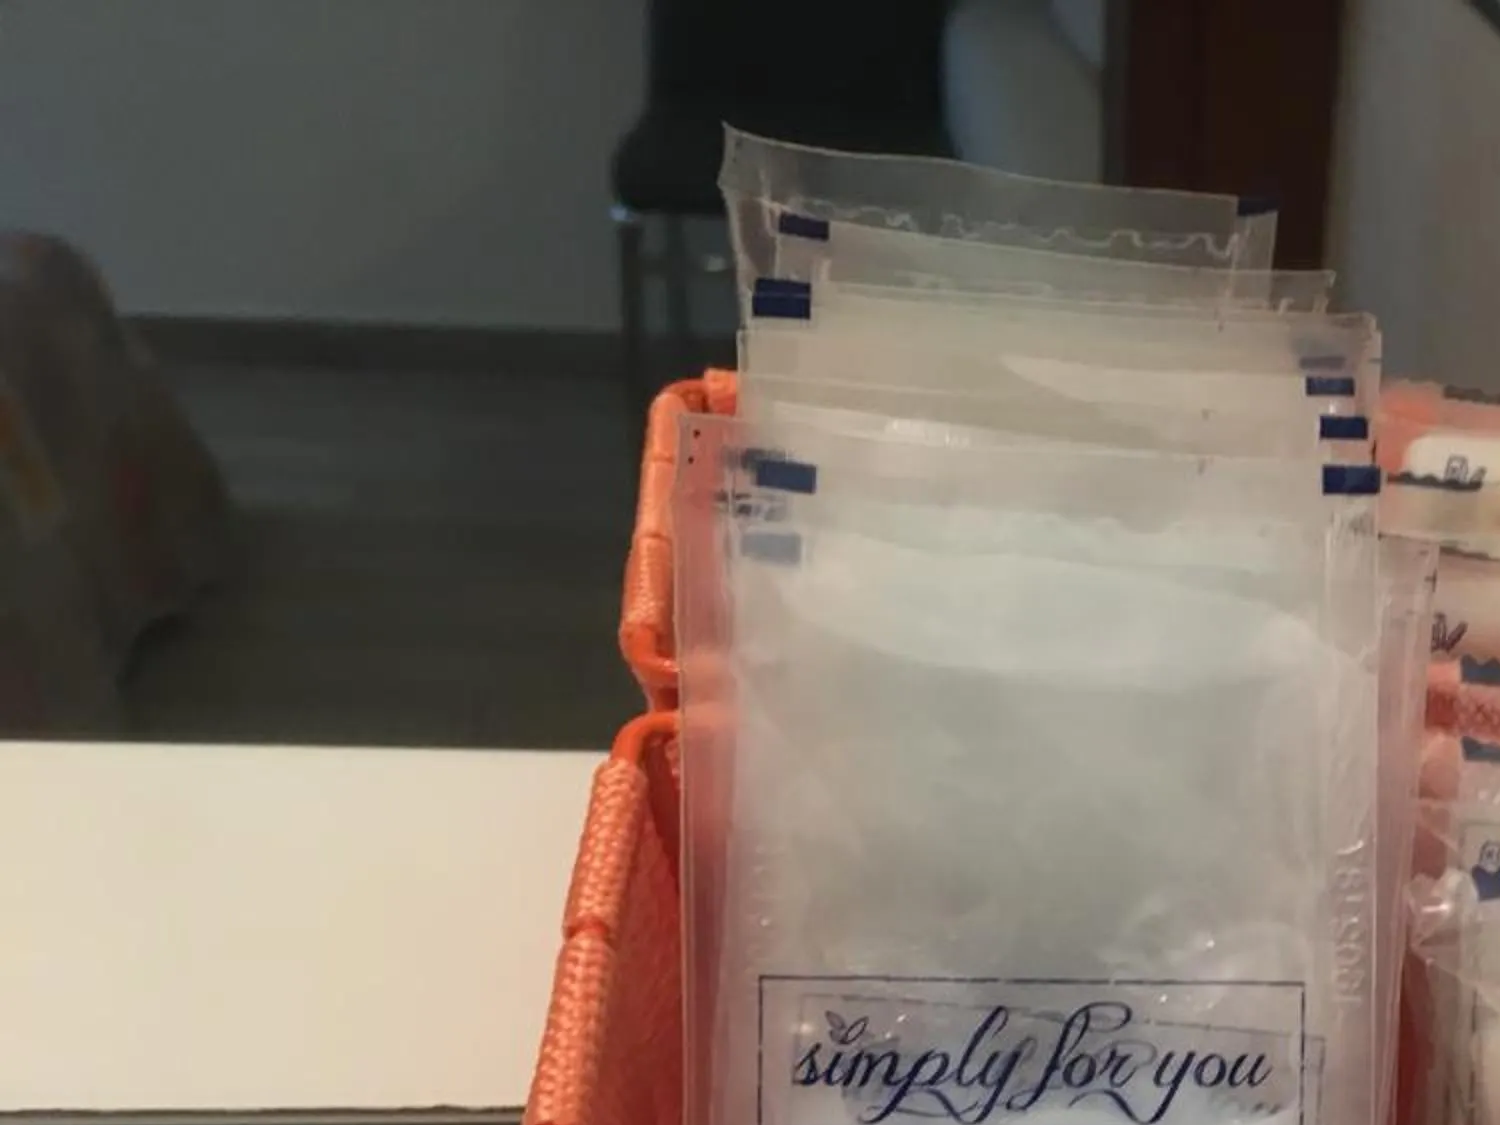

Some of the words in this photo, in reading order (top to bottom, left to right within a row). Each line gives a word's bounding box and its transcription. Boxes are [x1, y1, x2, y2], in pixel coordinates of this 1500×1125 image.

[793, 1005, 1022, 1125] simply
[1006, 1001, 1138, 1112] for
[1070, 1045, 1273, 1125] you
